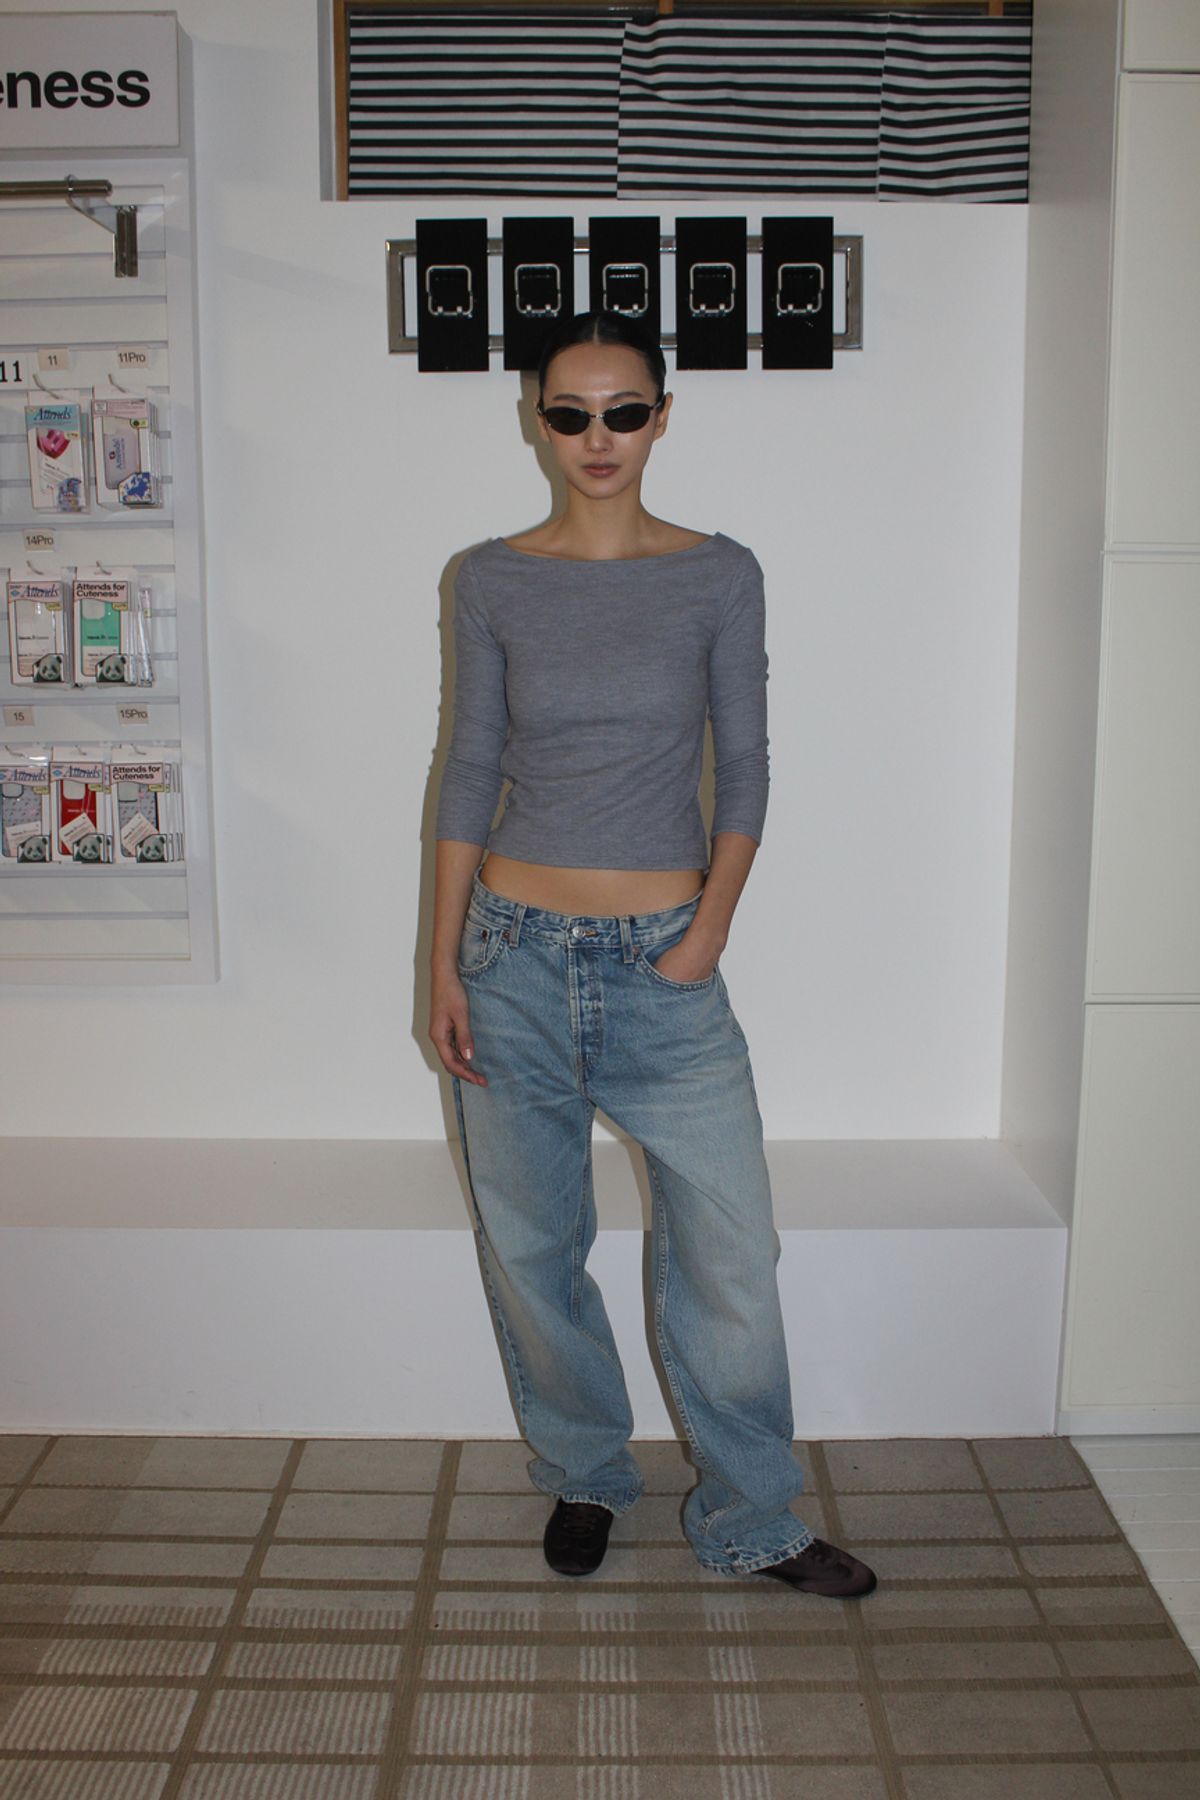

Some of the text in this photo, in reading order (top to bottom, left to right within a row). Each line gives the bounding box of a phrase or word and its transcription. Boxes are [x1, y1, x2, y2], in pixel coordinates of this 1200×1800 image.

[0, 69, 151, 109] ness
[47, 354, 59, 367] 11
[117, 351, 147, 363] 11Pro
[0, 360, 23, 383] 11
[26, 534, 54, 546] 14Pro
[76, 583, 126, 591] Attends for
[76, 590, 119, 598] Cuteness
[13, 711, 25, 722] 15
[119, 708, 148, 720] 15Pro
[113, 765, 161, 774] Attends for
[113, 773, 155, 781] Cuteness
